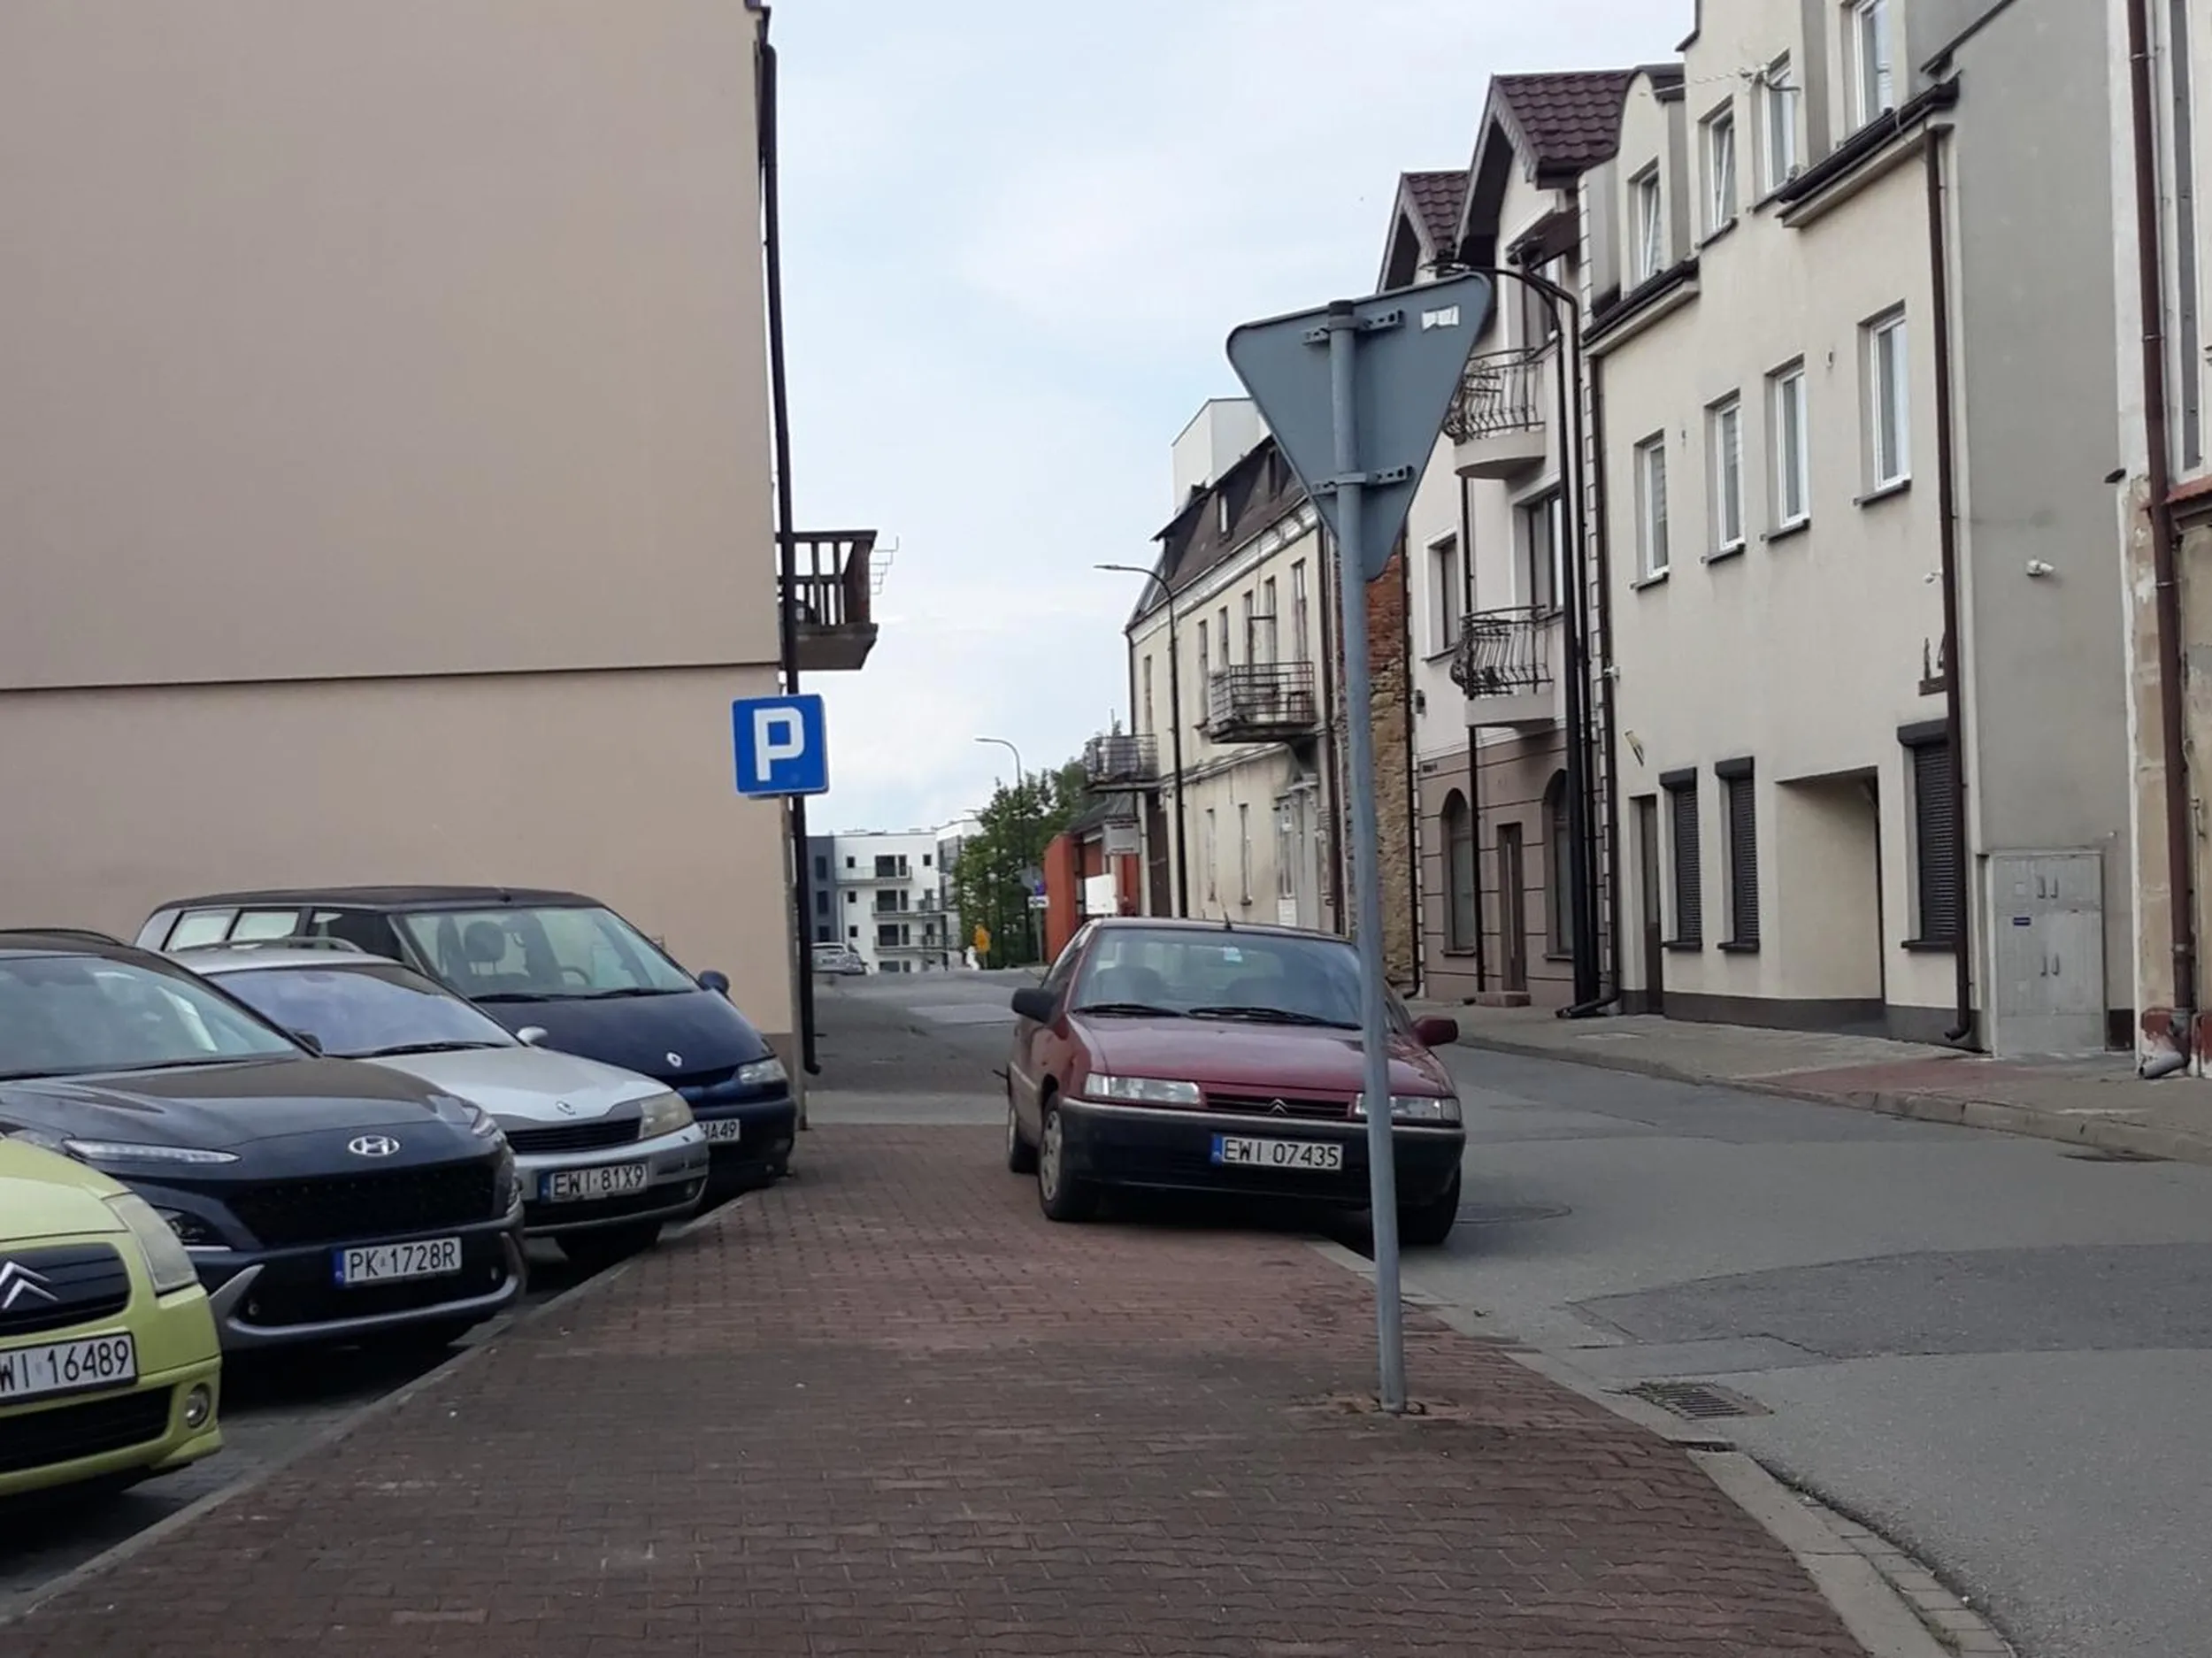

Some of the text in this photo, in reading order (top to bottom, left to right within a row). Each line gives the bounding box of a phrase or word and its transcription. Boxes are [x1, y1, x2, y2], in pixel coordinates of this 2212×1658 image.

[753, 707, 804, 781] P
[1225, 1140, 1339, 1167] EWI 07435
[555, 1166, 644, 1195] EWI 81X9
[349, 1241, 456, 1278] PK 1728R
[48, 1339, 129, 1385] 16489
